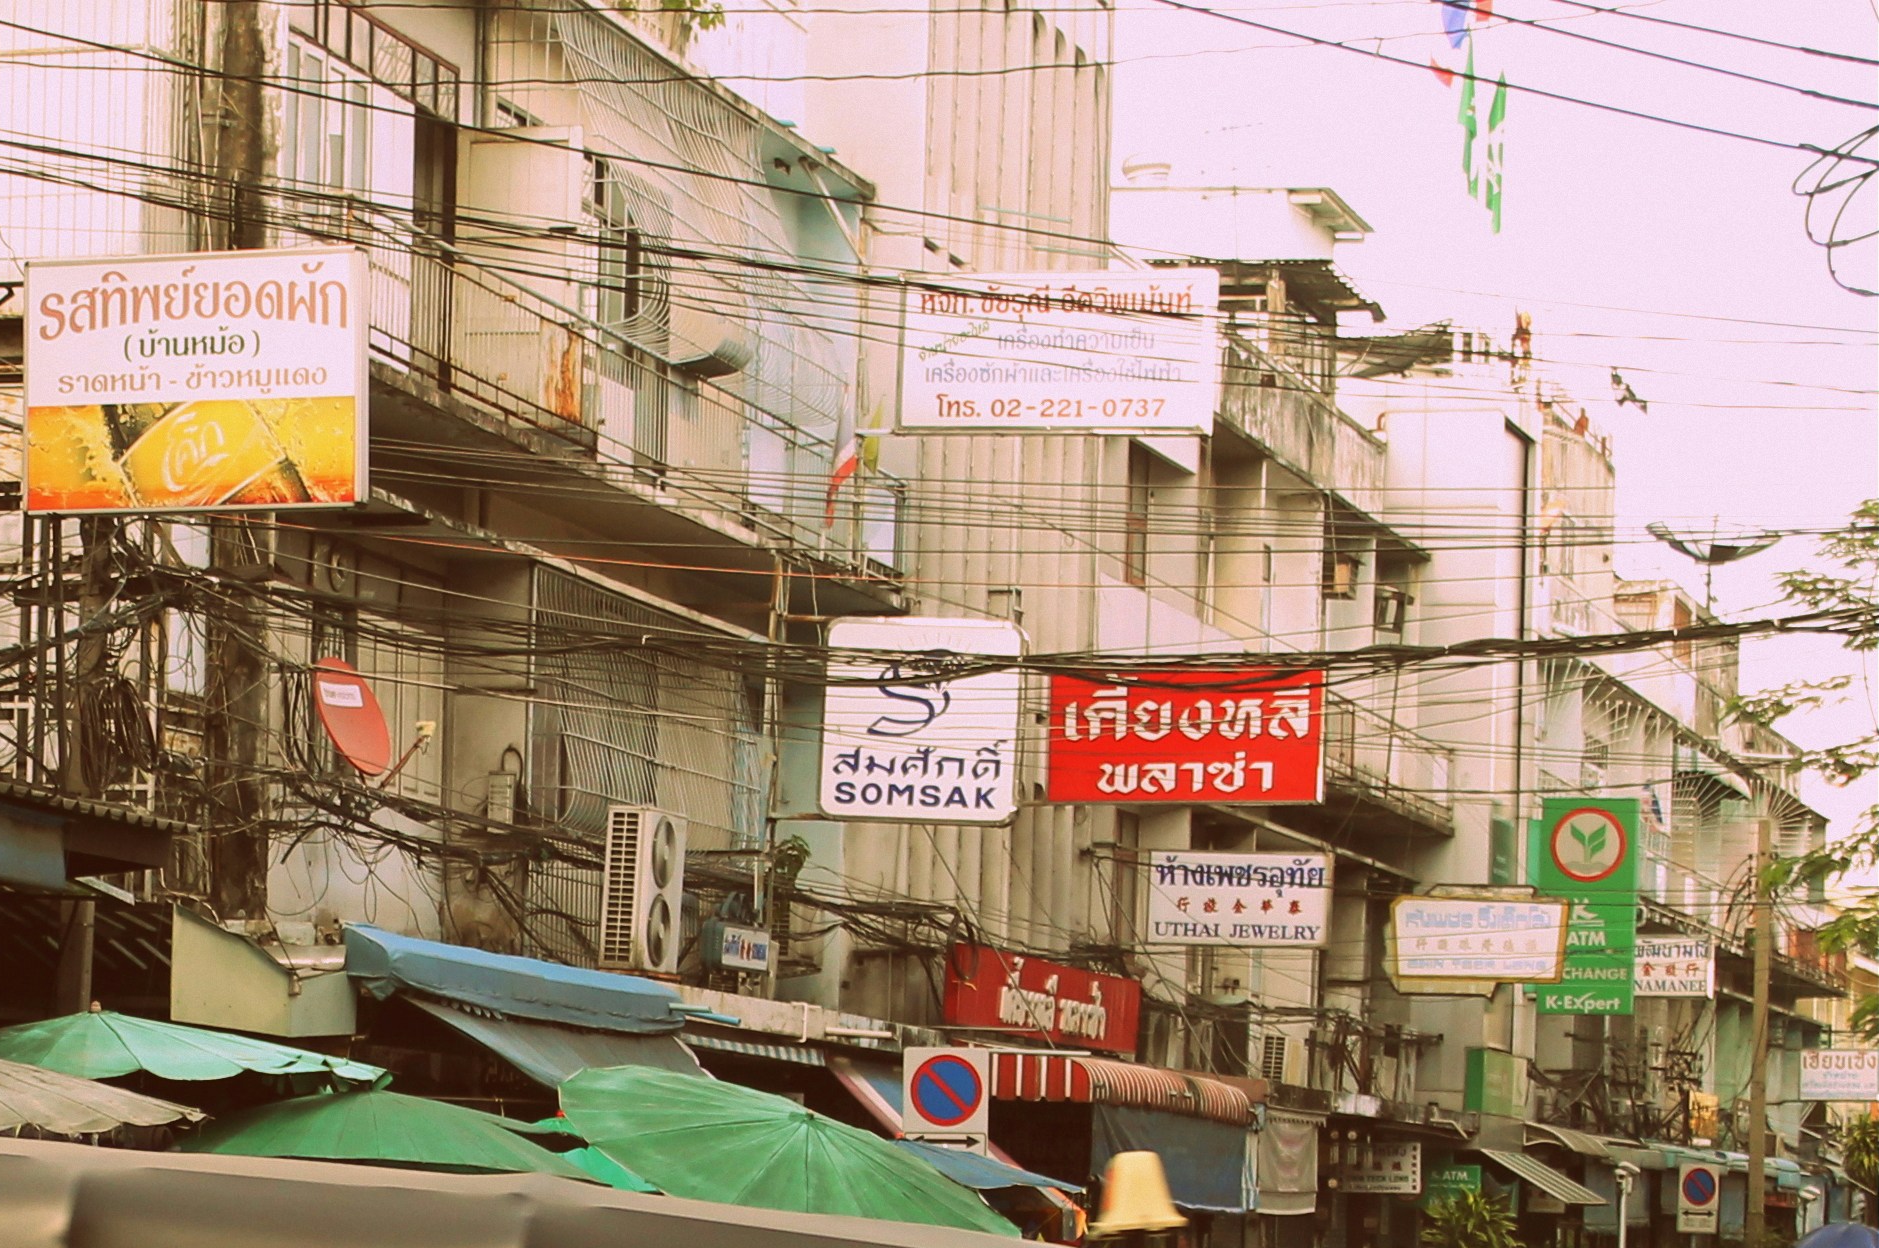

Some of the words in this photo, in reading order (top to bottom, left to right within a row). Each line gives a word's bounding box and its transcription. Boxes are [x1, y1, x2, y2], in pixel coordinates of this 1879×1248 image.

[38, 260, 349, 341] รสทิพย์ยอดผัก
[58, 365, 162, 394] ราดหน้า
[185, 362, 329, 395] ข้าวหมูแดง
[936, 393, 981, 419] โทร.
[990, 397, 1167, 419] 02-221-0737
[831, 739, 1010, 780] สมศักดิ์
[1096, 750, 1276, 796] พลาซ่า
[833, 781, 998, 810] SOMSAK
[1154, 921, 1221, 938] UTHAI
[1229, 924, 1321, 941] JEWELRY
[1566, 931, 1607, 946] ATM
[1545, 992, 1622, 1014] K-Expert
[1442, 1171, 1468, 1181] ATM
